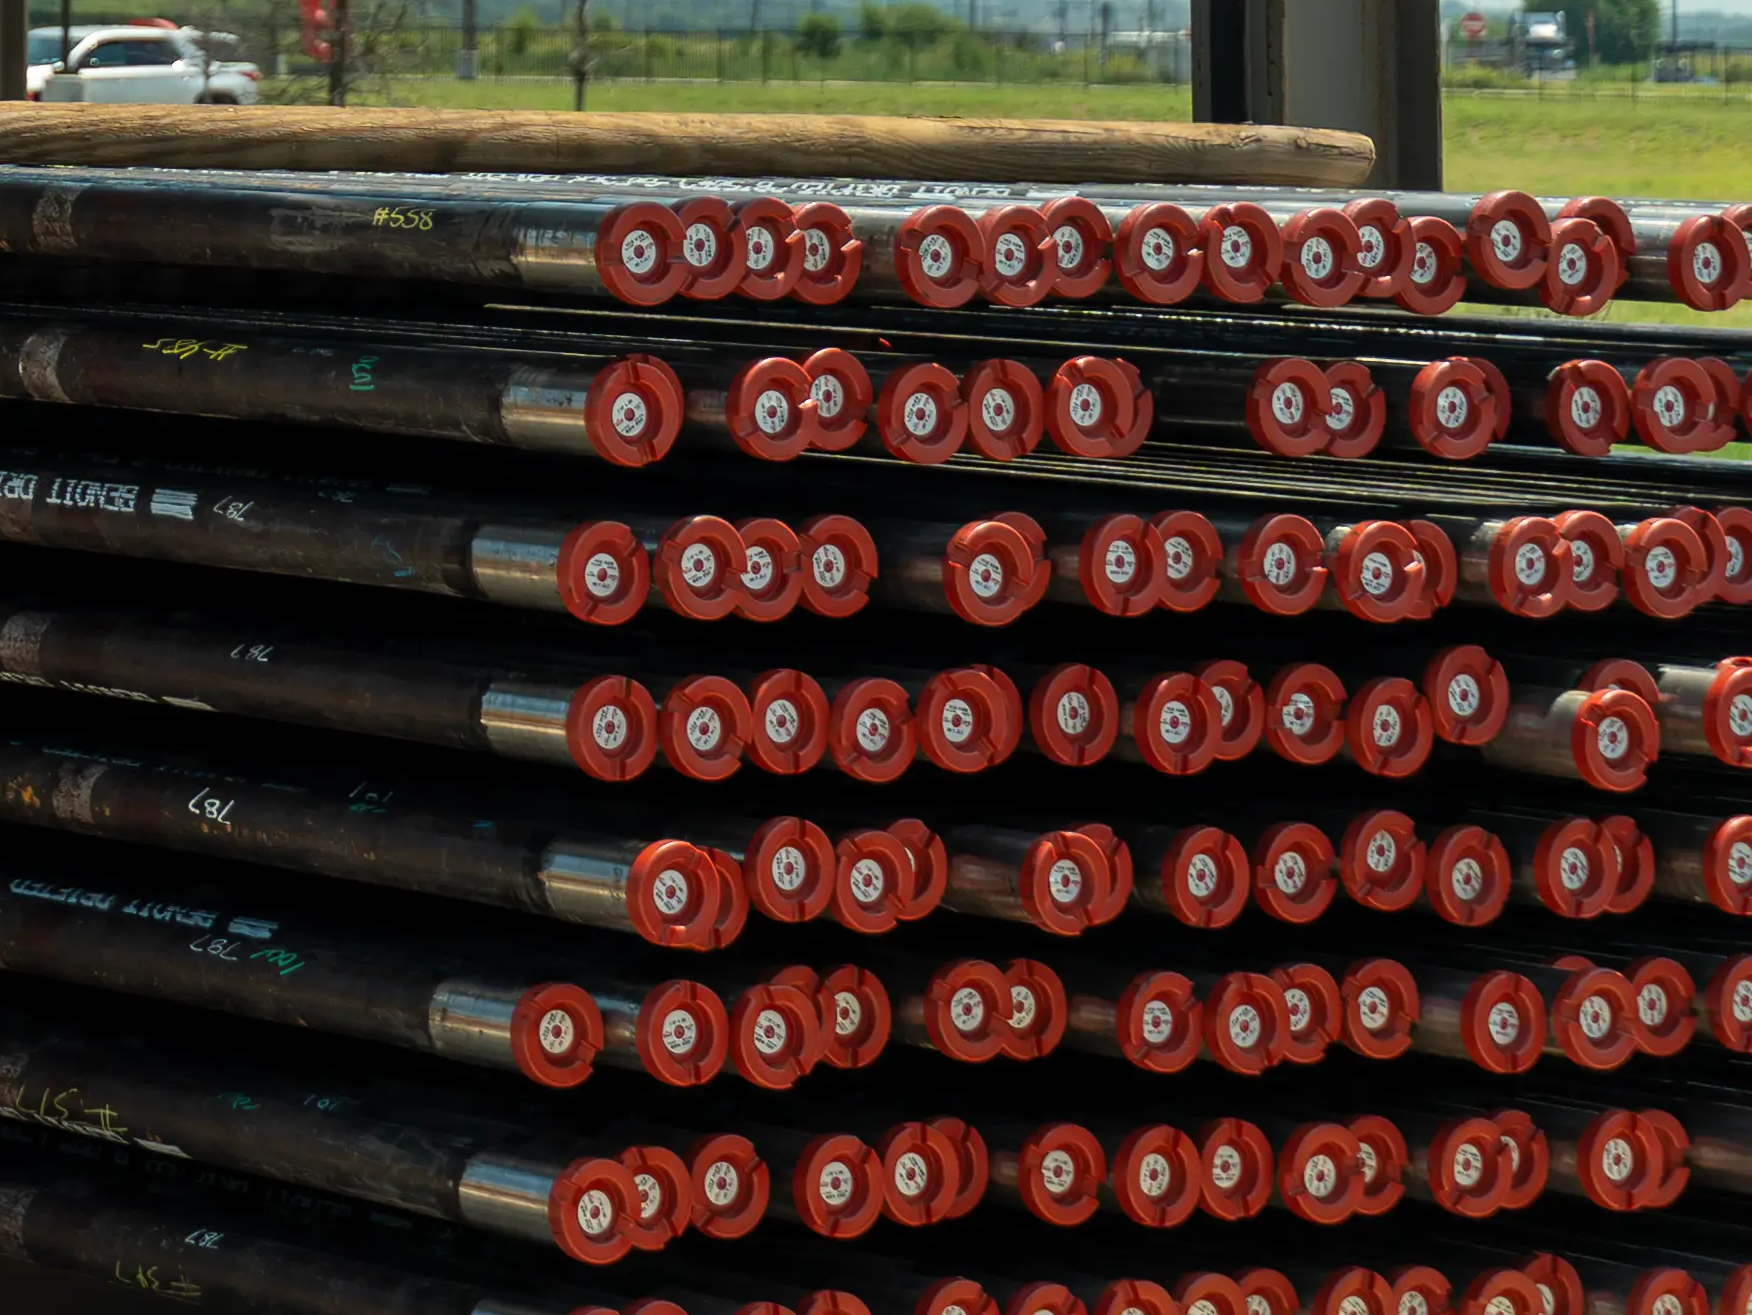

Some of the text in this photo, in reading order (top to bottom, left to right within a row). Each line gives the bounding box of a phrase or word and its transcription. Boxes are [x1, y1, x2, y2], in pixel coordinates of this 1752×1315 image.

[373, 206, 436, 230] #558
[46, 479, 140, 512] BENOIT
[214, 495, 254, 521] 787
[187, 787, 235, 825] 787
[189, 934, 241, 961] 787
